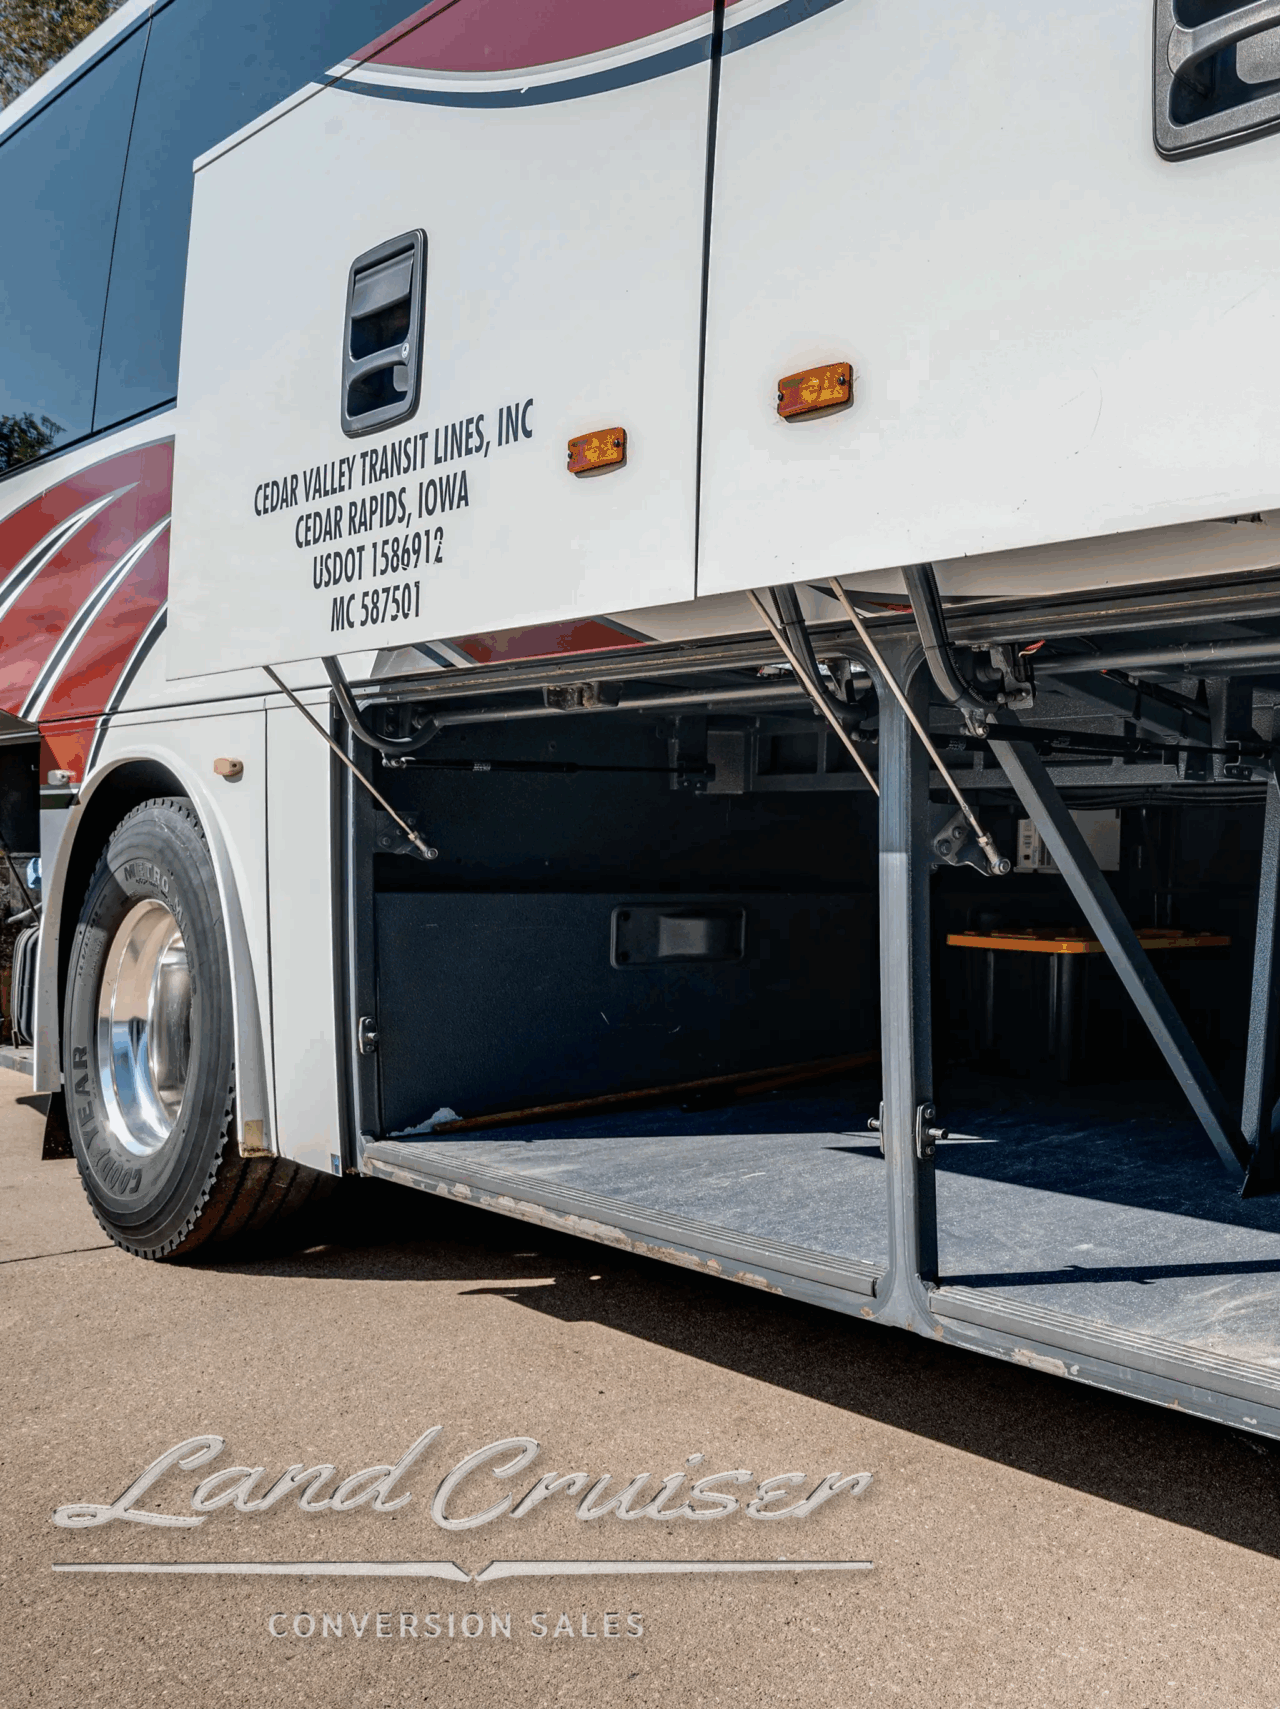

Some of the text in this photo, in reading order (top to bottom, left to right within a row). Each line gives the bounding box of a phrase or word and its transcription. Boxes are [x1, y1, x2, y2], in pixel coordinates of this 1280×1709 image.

[254, 398, 534, 517] CEDAR VALLEY TRANSIT LINES, INC
[295, 469, 470, 549] CEDAR RAPIDS, IOWA
[313, 526, 444, 590] USDOT 1586912
[330, 580, 421, 632] MC 587501
[123, 861, 169, 894] METRO
